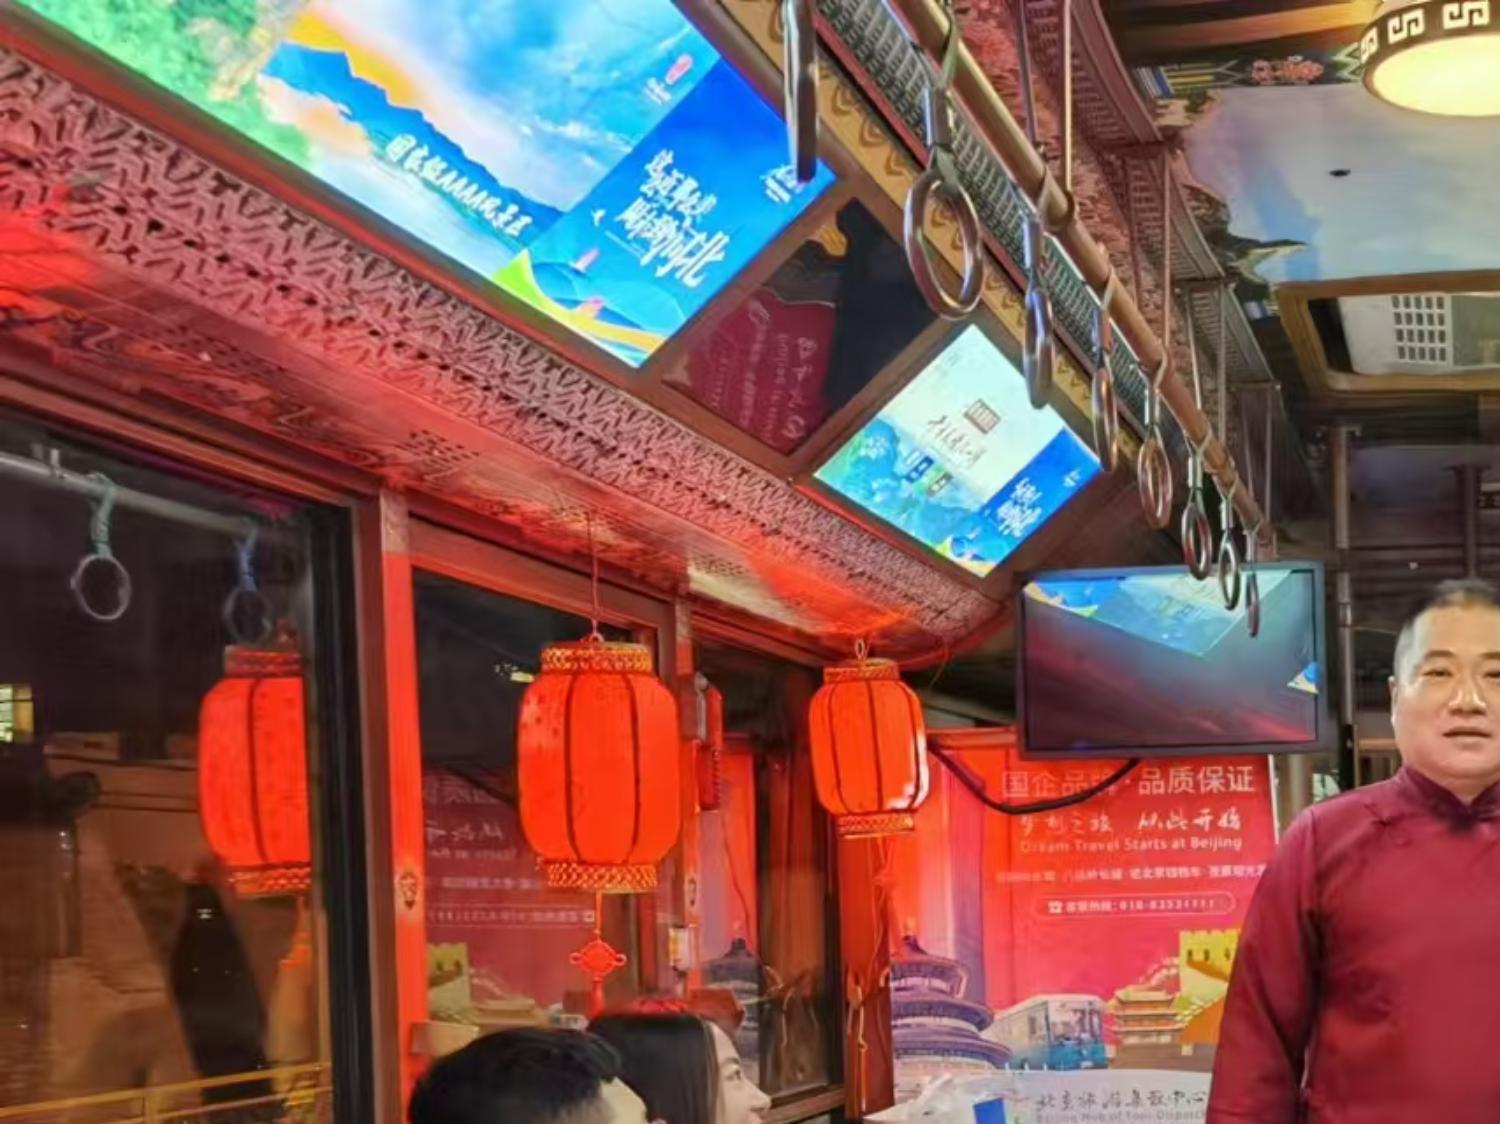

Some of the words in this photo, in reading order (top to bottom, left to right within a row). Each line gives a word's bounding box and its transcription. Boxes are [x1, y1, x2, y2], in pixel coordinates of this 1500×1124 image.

[1124, 836, 1167, 851] Starts
[1171, 838, 1185, 850] at
[1190, 836, 1242, 852] Beijing
